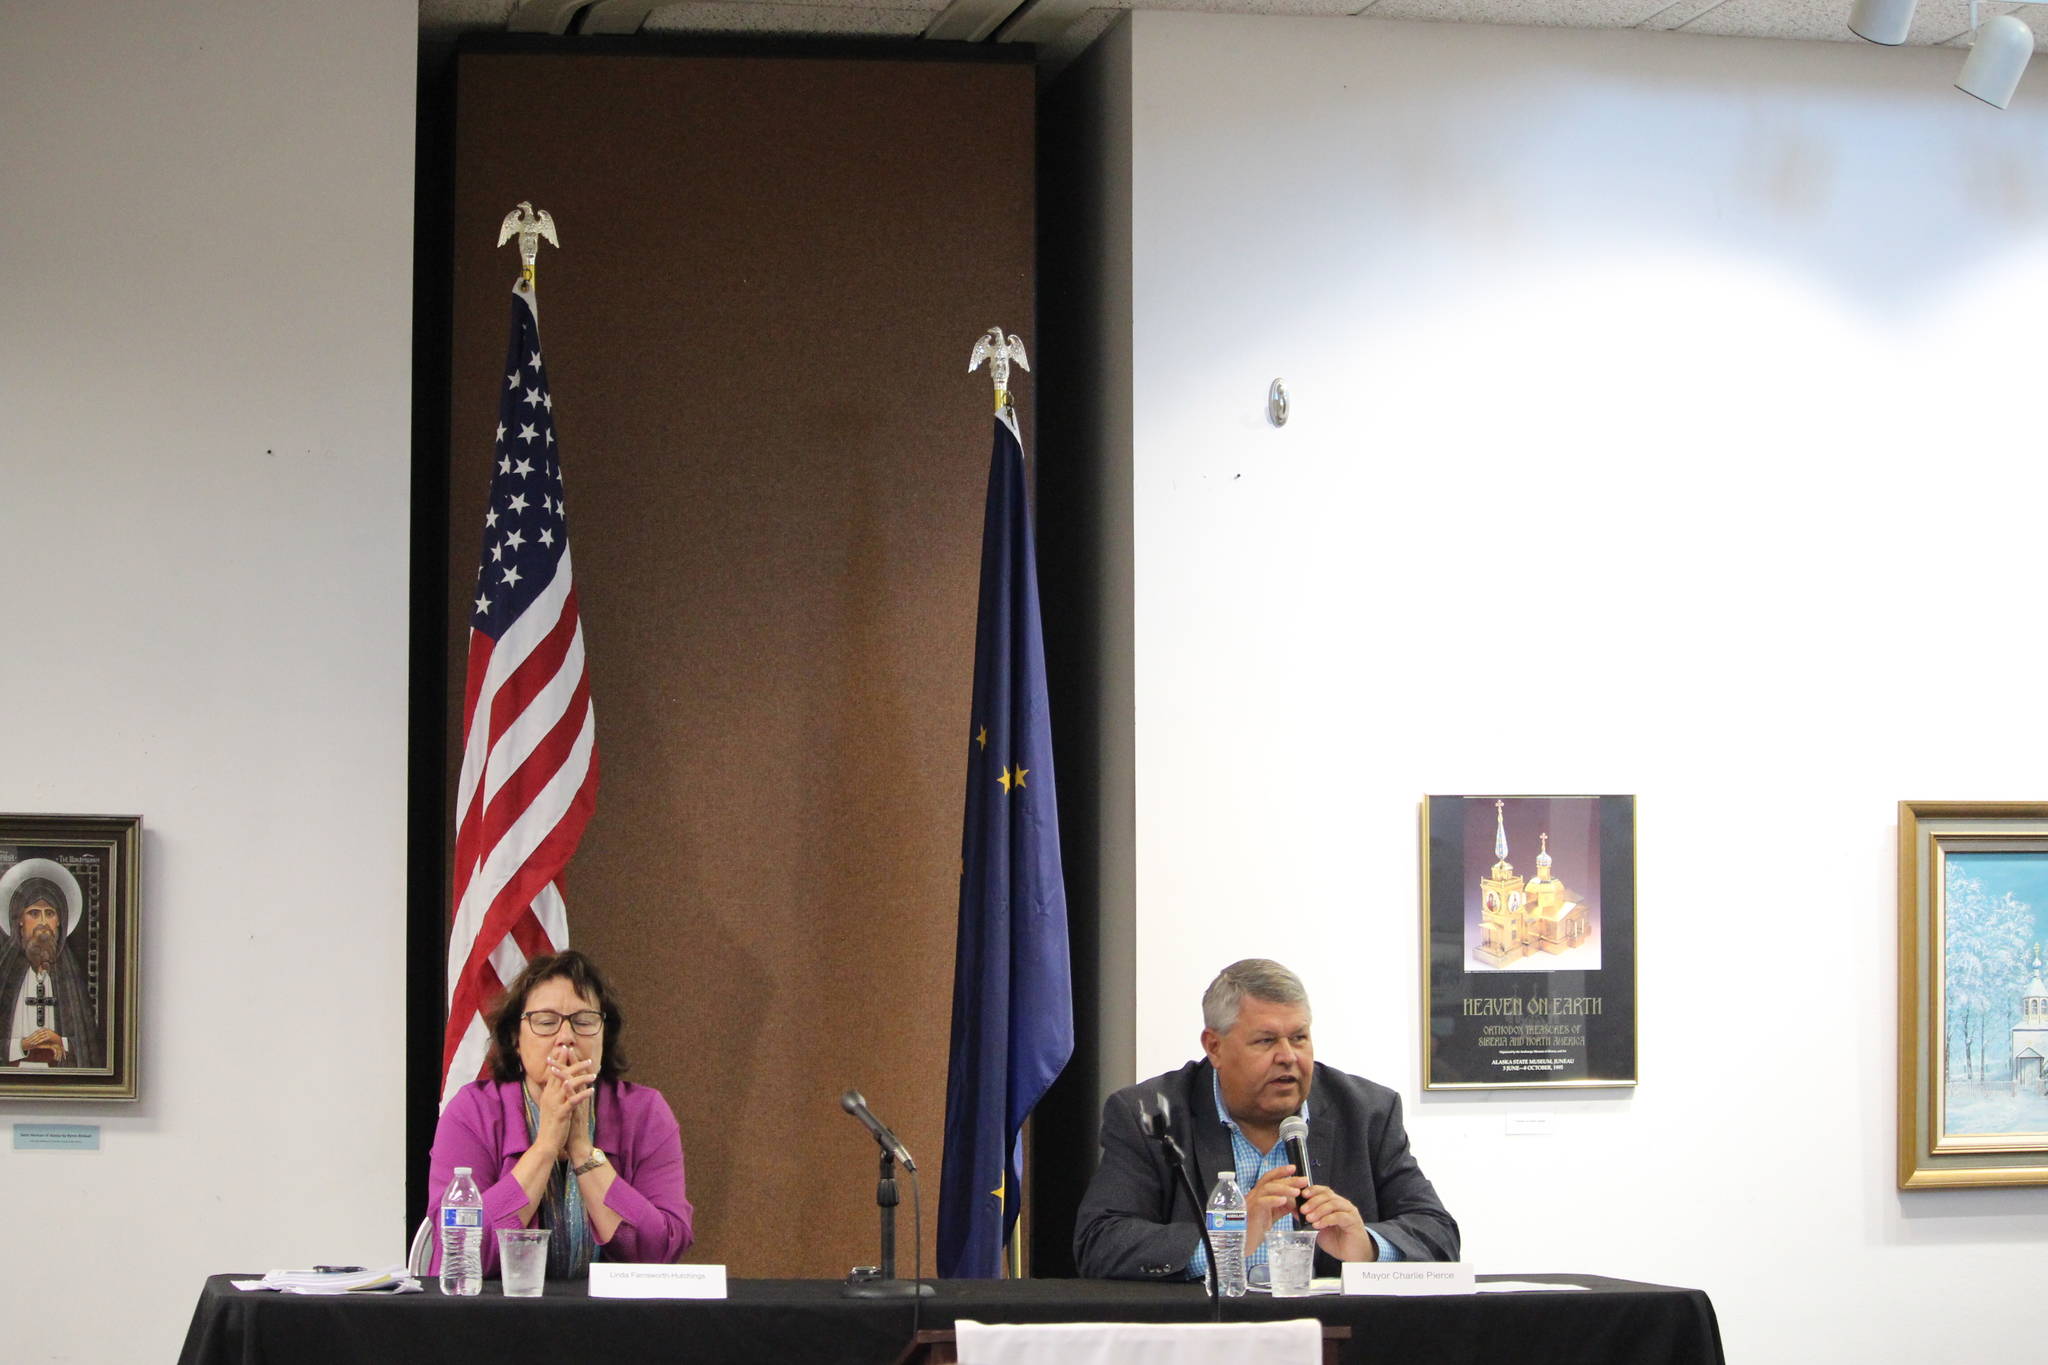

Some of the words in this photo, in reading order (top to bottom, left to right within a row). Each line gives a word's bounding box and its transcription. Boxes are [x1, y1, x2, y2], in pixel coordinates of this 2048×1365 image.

[1463, 998, 1523, 1016] HEAVEN
[1527, 996, 1548, 1016] ON
[1553, 997, 1602, 1016] EARTH
[1483, 1025, 1524, 1036] ORTHODOX
[1571, 1025, 1582, 1035] OF
[1478, 1037, 1507, 1047] SIBERIA
[1509, 1037, 1525, 1047] AND
[1526, 1036, 1551, 1046] NORTH
[1552, 1036, 1585, 1046] AMERICA
[610, 1271, 629, 1279] Linda
[1362, 1271, 1390, 1281] Mayor
[1392, 1271, 1424, 1280] Charlie
[1426, 1271, 1455, 1280] Pierce
